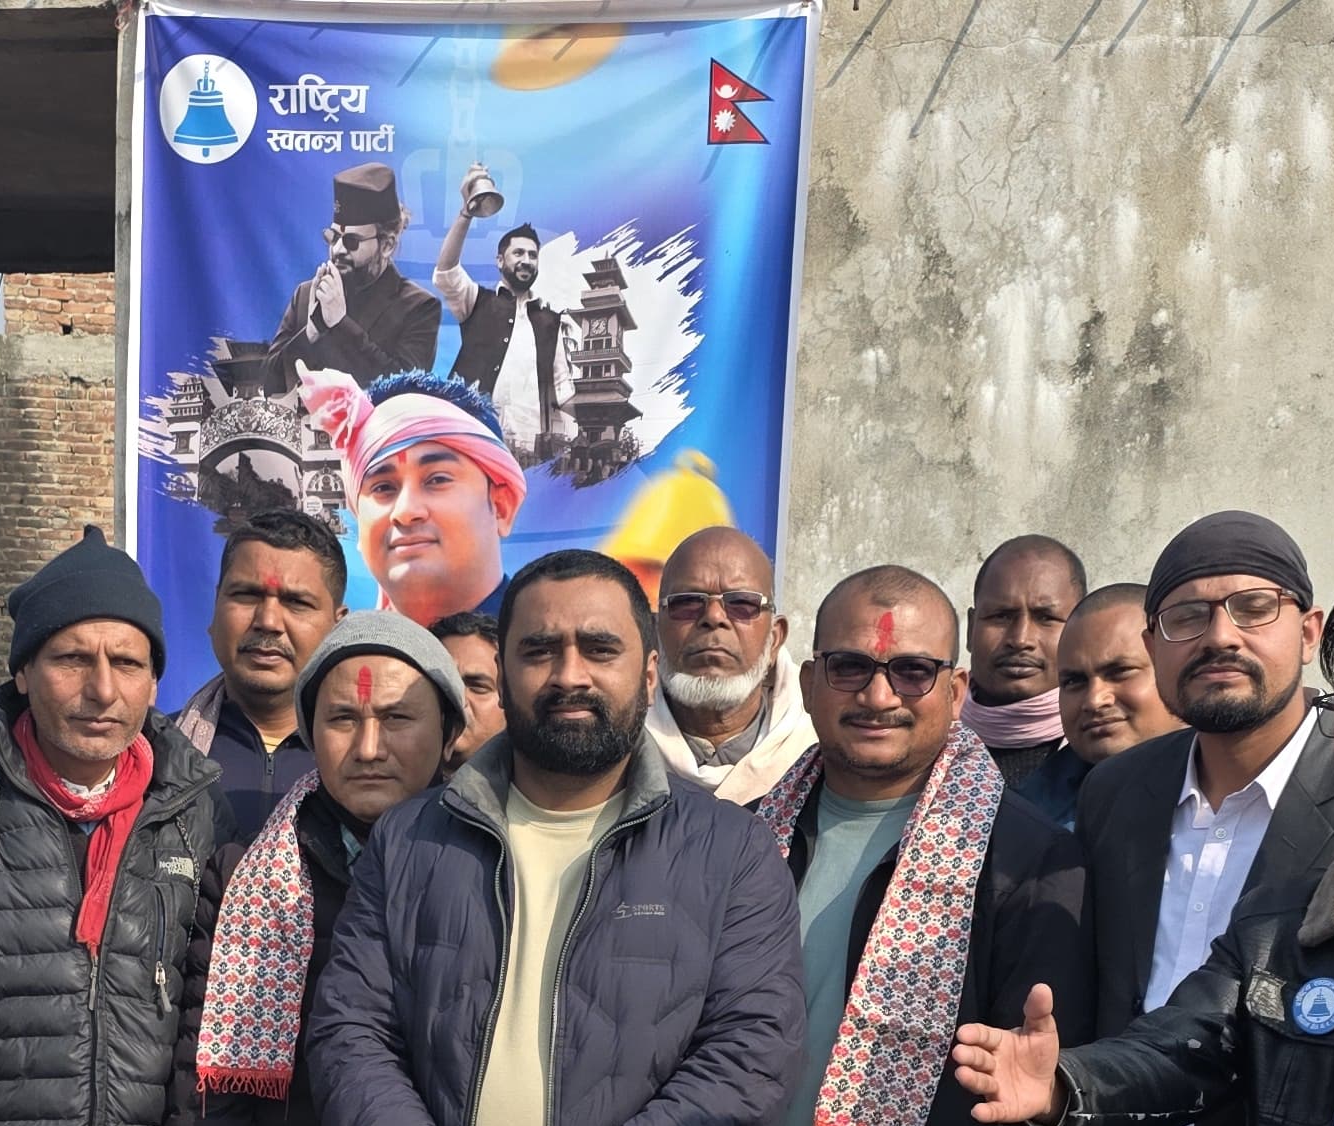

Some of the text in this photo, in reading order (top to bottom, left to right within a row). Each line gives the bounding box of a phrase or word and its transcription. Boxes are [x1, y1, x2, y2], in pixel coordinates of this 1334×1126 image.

[268, 73, 370, 123] राष्ट्रिय
[266, 124, 396, 154] स्वतन्त्र पार्टी
